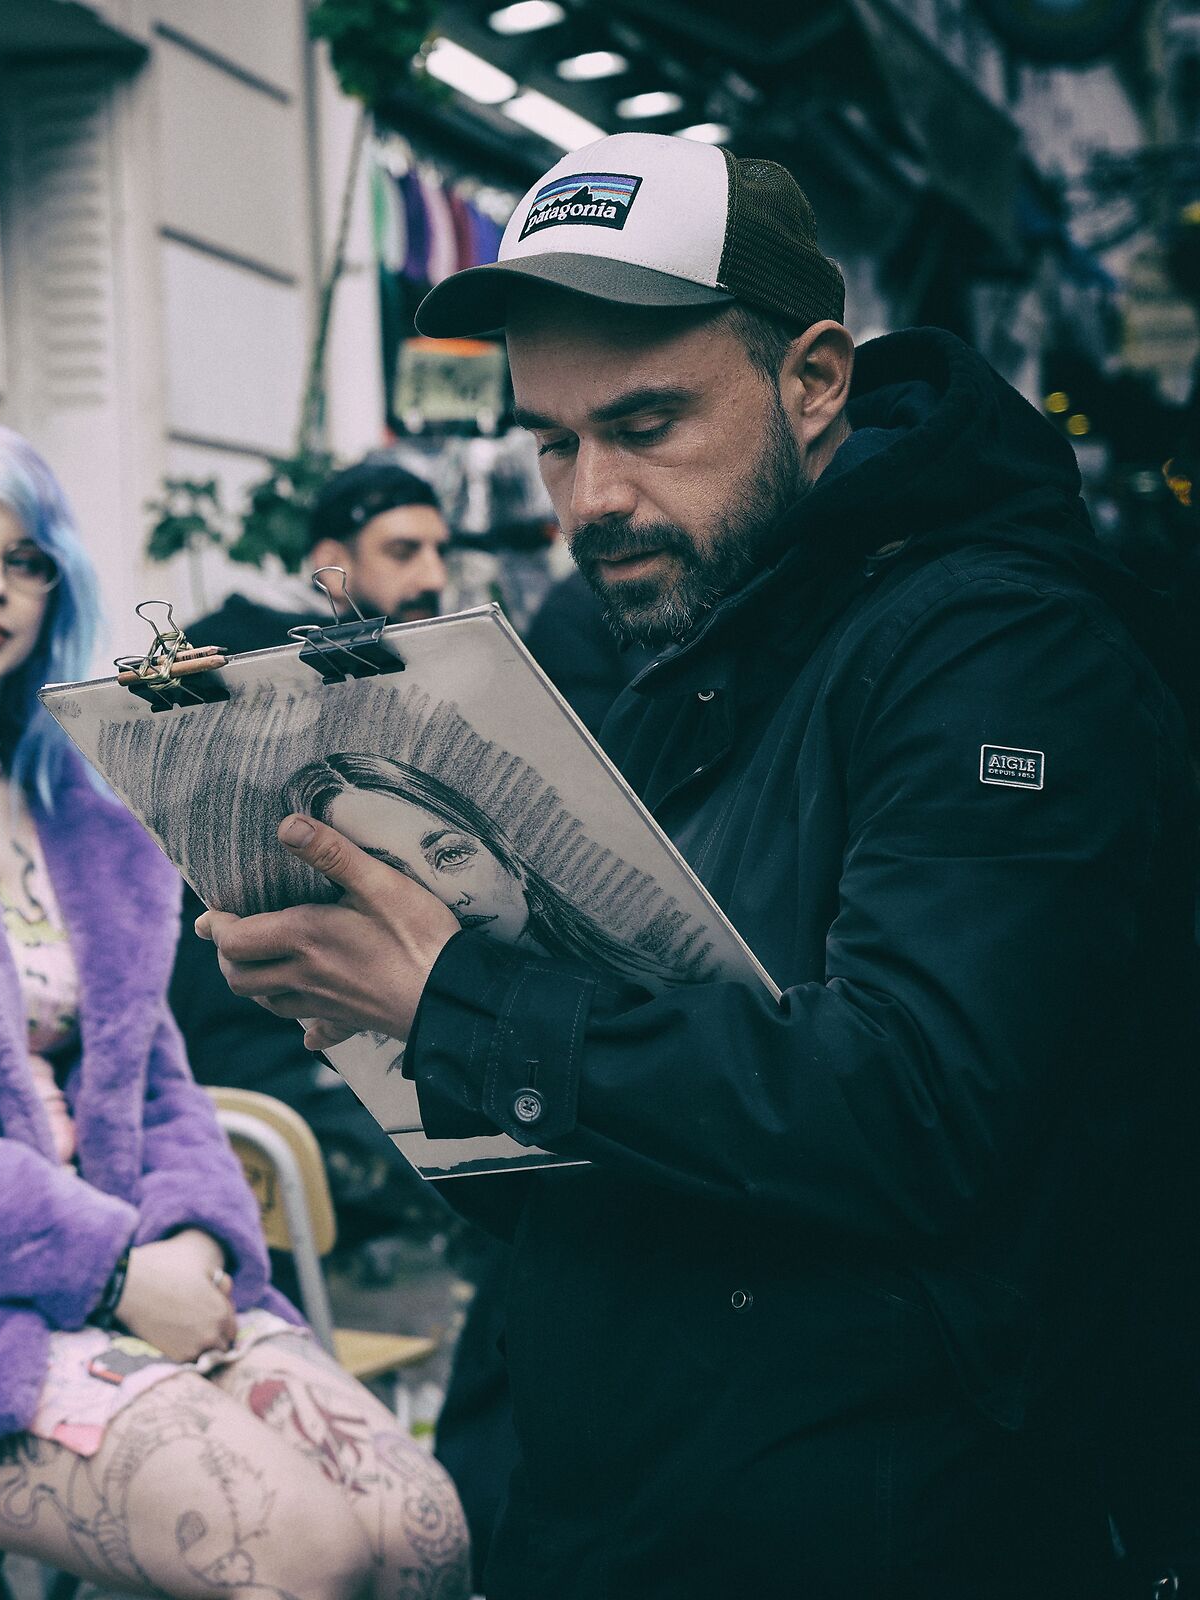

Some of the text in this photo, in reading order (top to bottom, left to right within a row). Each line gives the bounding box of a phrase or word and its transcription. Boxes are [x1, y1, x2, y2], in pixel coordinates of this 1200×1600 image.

[524, 202, 617, 233] patagonia
[988, 755, 1035, 772] AIGLE
[988, 768, 1015, 776] DEPUIS
